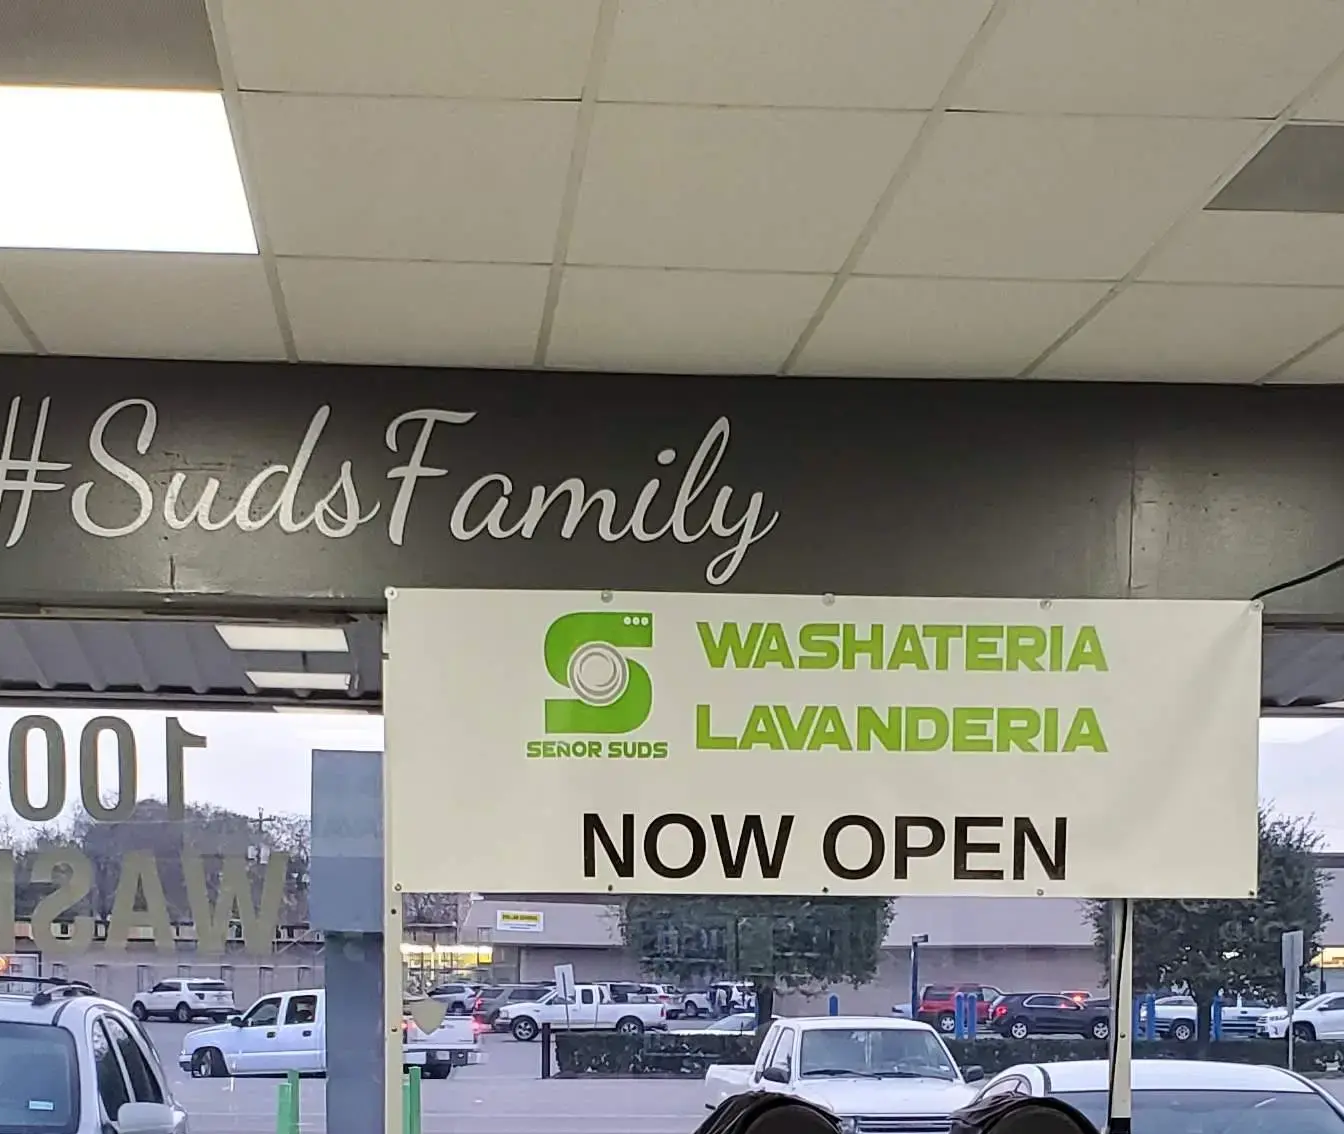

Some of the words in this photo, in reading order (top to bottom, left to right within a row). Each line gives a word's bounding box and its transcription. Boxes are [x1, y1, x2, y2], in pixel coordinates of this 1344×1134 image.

[696, 622, 1109, 672] WASHATERIA
[608, 741, 668, 758] SUDS
[696, 704, 1109, 753] LAVANDERIA
[583, 813, 795, 881] NOW
[822, 814, 1068, 882] OPEN
